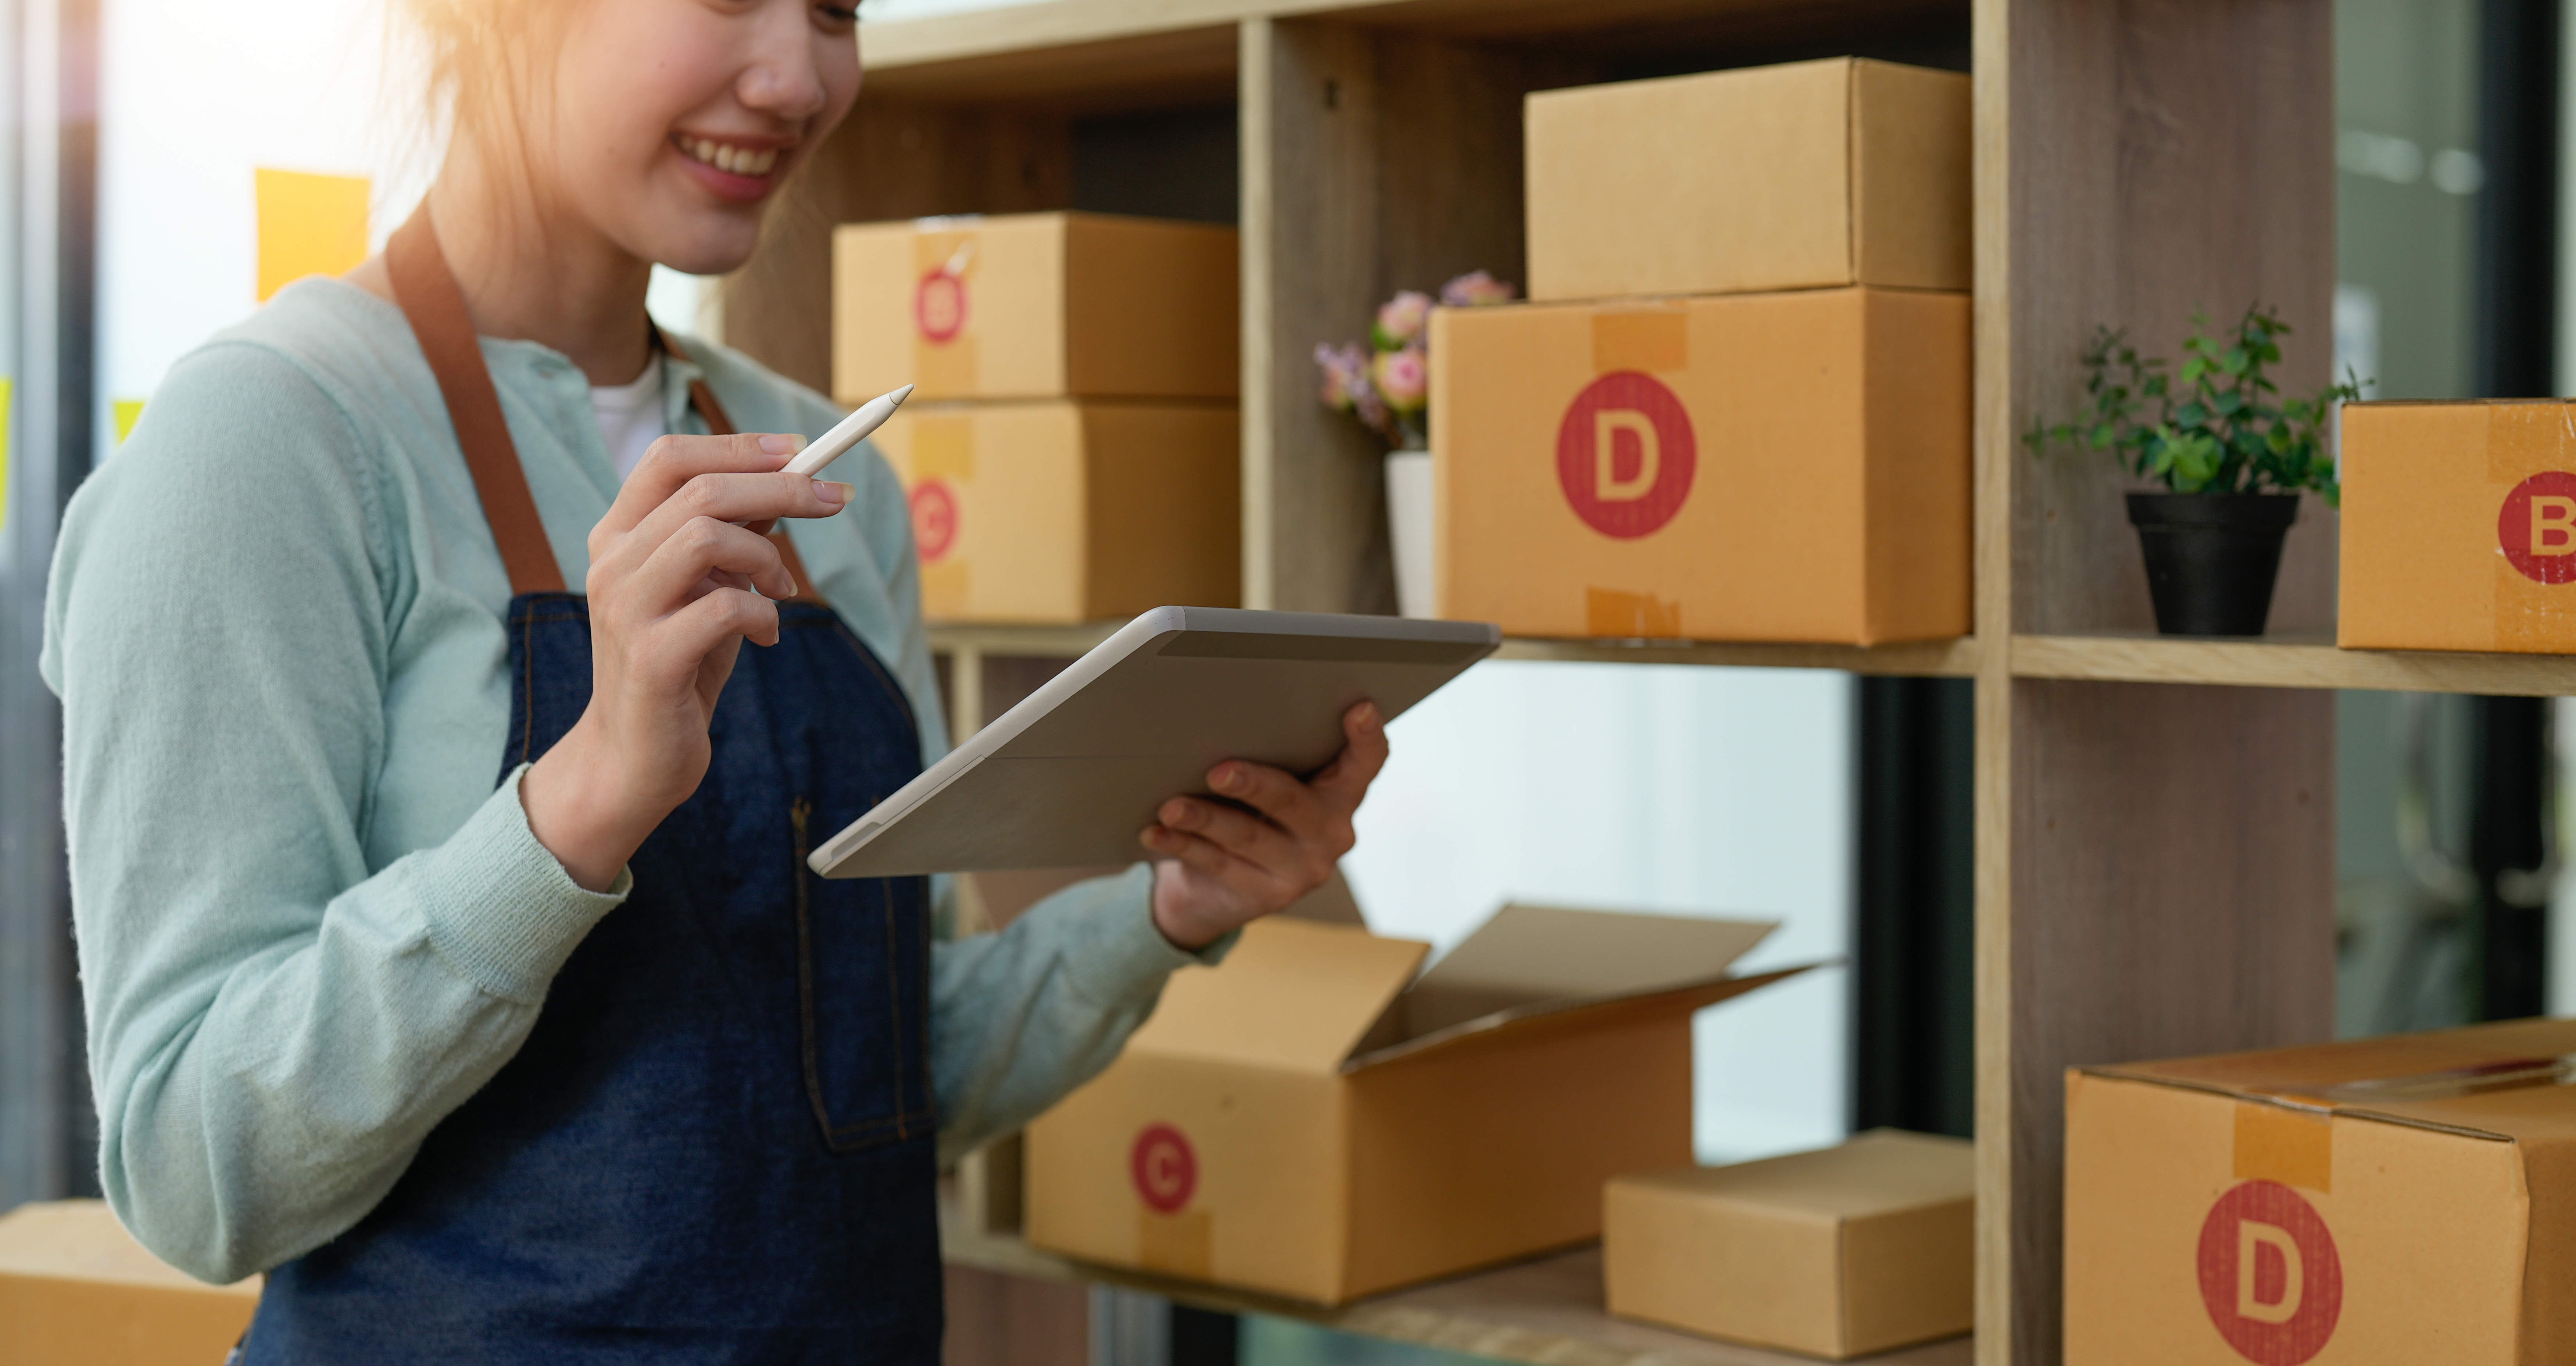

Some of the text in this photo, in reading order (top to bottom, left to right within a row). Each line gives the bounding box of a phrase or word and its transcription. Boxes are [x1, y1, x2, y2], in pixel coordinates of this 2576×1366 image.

[1595, 409, 1660, 502] D
[2531, 496, 2576, 556] B
[1146, 1141, 1181, 1196] C
[2238, 1219, 2304, 1324] D
